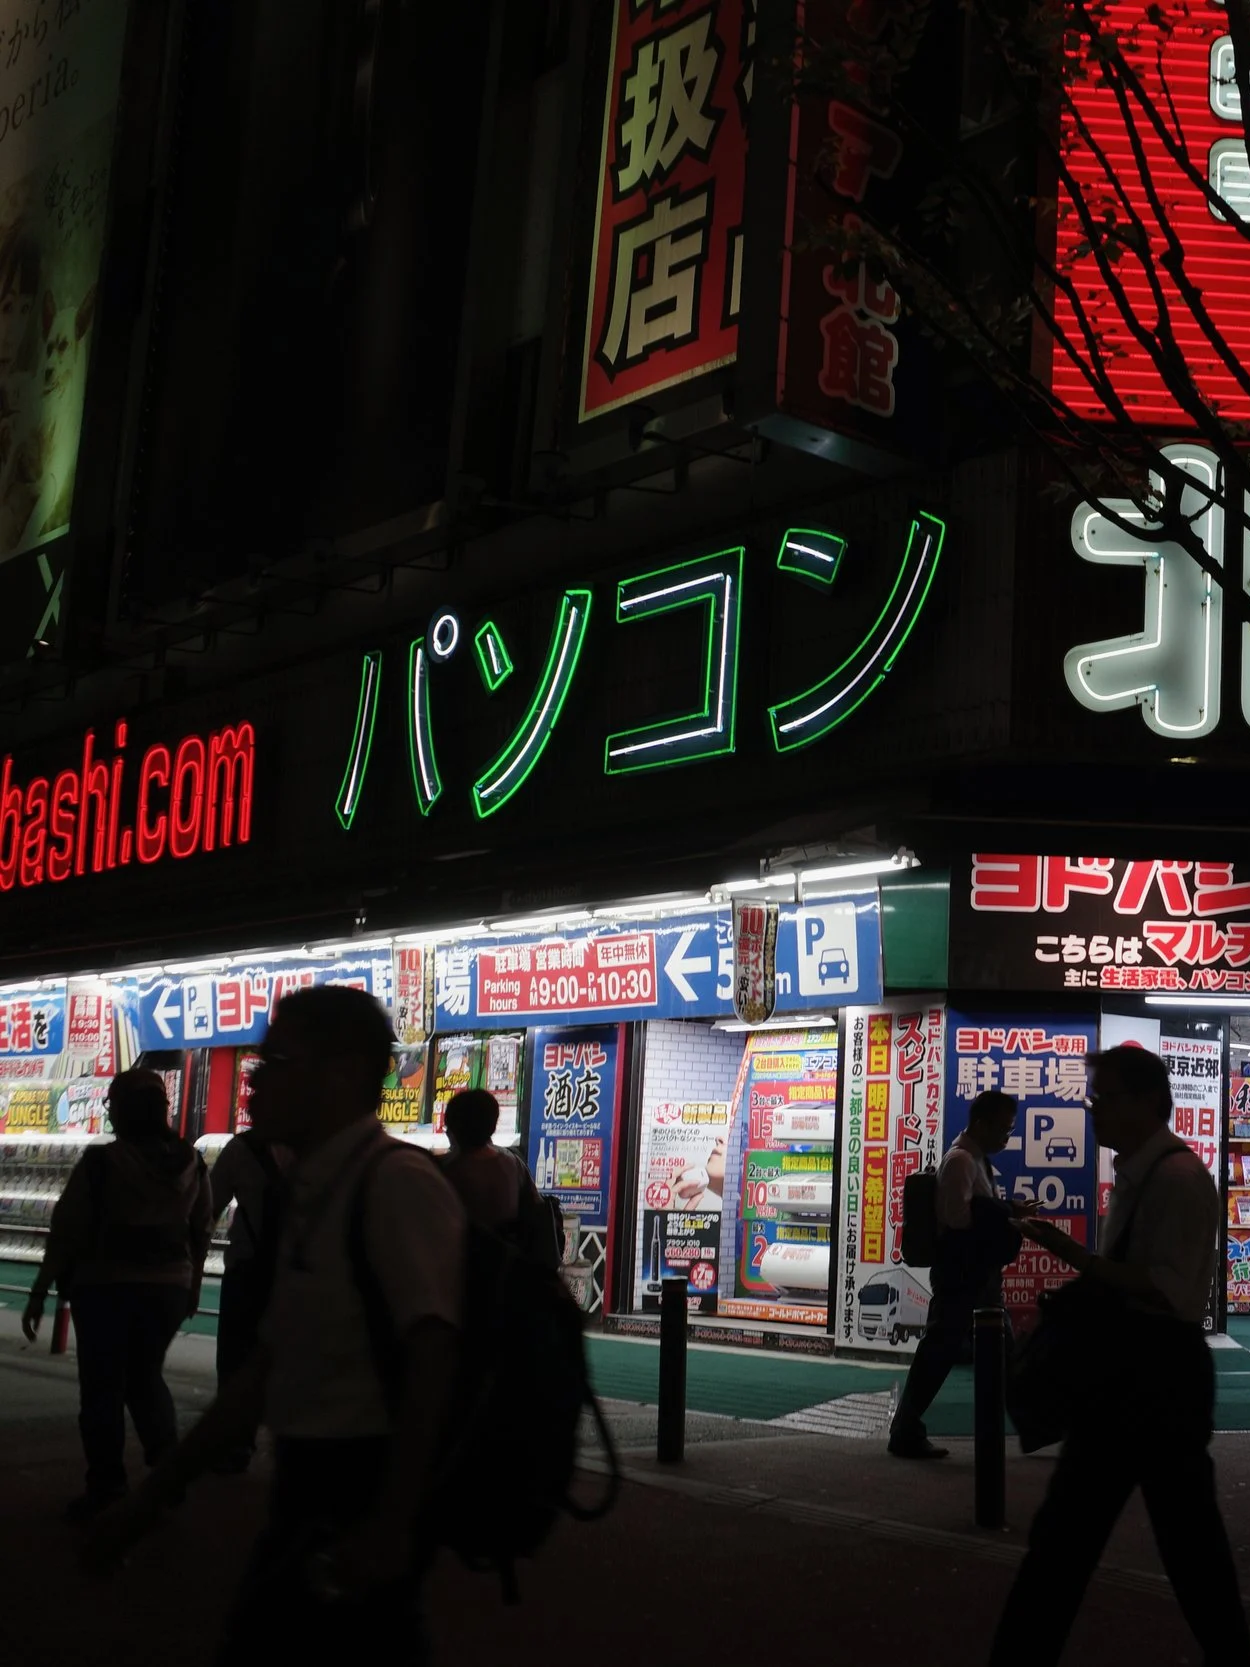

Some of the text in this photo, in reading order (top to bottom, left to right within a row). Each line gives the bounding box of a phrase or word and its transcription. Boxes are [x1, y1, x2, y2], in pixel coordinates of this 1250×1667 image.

[335, 511, 946, 830] パソコン
[535, 947, 585, 971] 営業時間
[601, 941, 647, 962] 年中無休
[484, 978, 521, 996] Parking
[489, 997, 518, 1012] hours
[544, 1043, 606, 1069] ヨドバシ
[869, 1017, 891, 1074] 本日
[1162, 1041, 1219, 1055] ヨドバシカメラは
[956, 1056, 1089, 1102] 駐車場
[1162, 1055, 1219, 1079] 東京近郊
[545, 1069, 601, 1121] 酒店
[7, 1104, 49, 1127] JUNGLE
[867, 1081, 888, 1140] 明日
[1174, 1107, 1216, 1138] 明日
[864, 1149, 886, 1262] ご希望日
